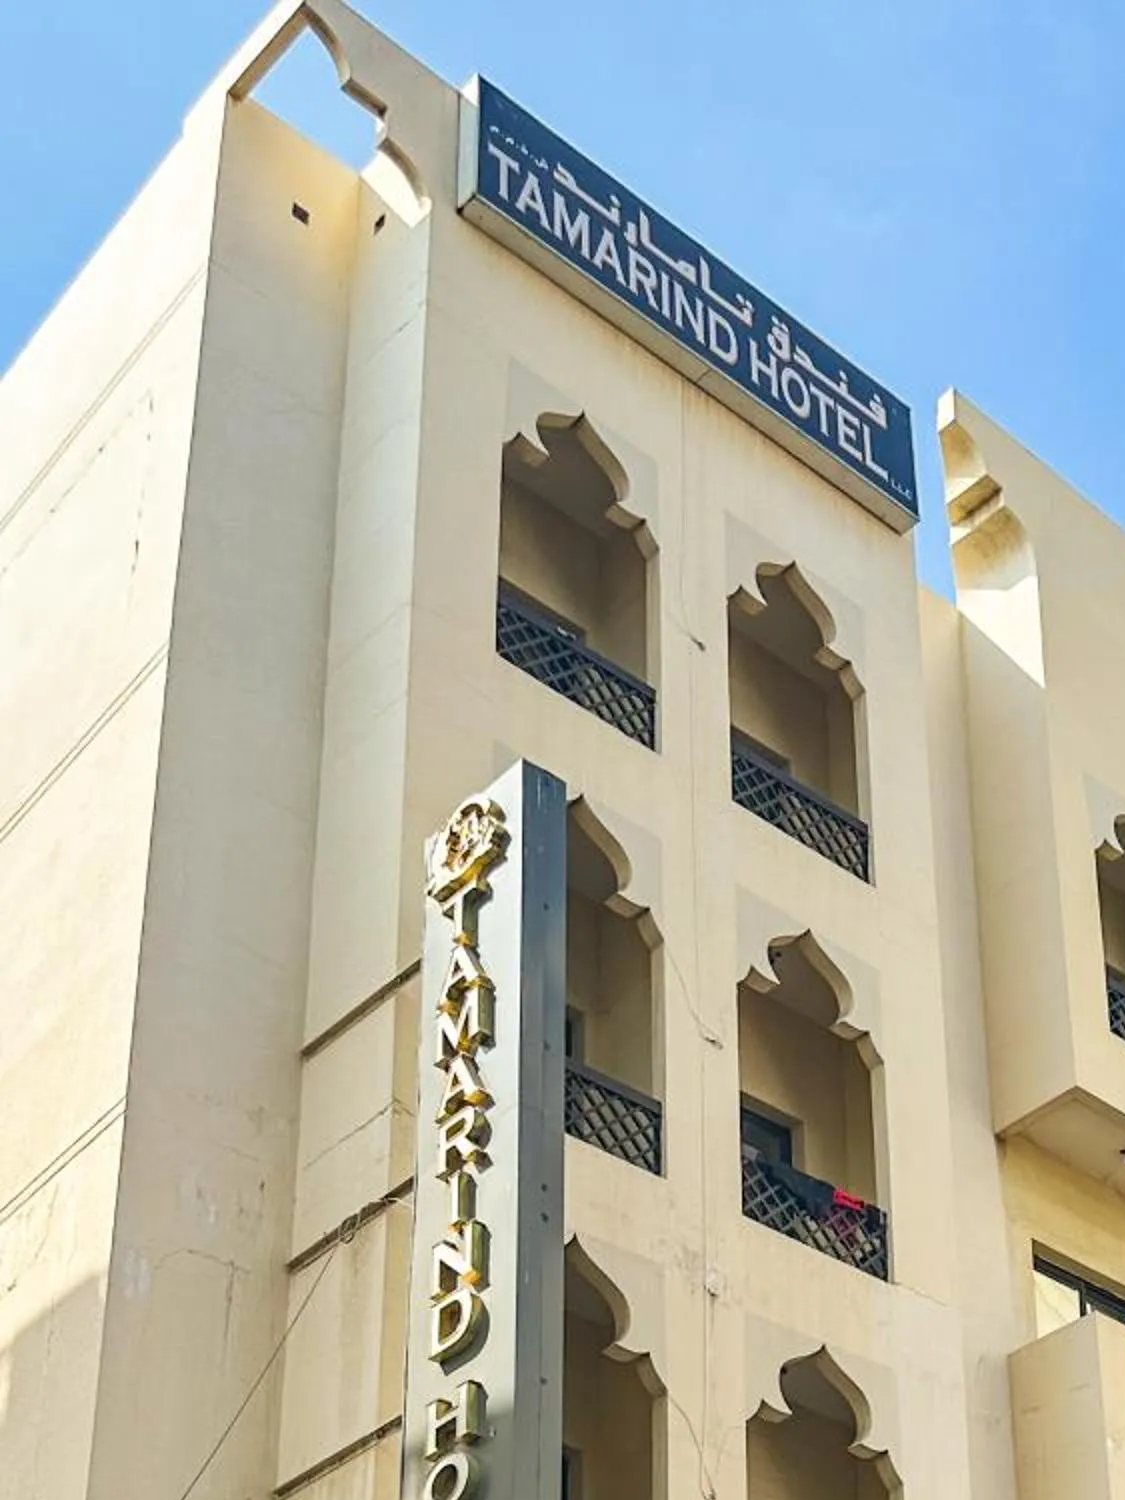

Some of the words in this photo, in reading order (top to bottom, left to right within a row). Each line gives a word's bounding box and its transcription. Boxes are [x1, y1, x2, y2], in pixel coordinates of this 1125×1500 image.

[487, 140, 739, 367] TAMARIND
[748, 337, 889, 482] HOTEL
[430, 879, 491, 1363] TAMARIND
